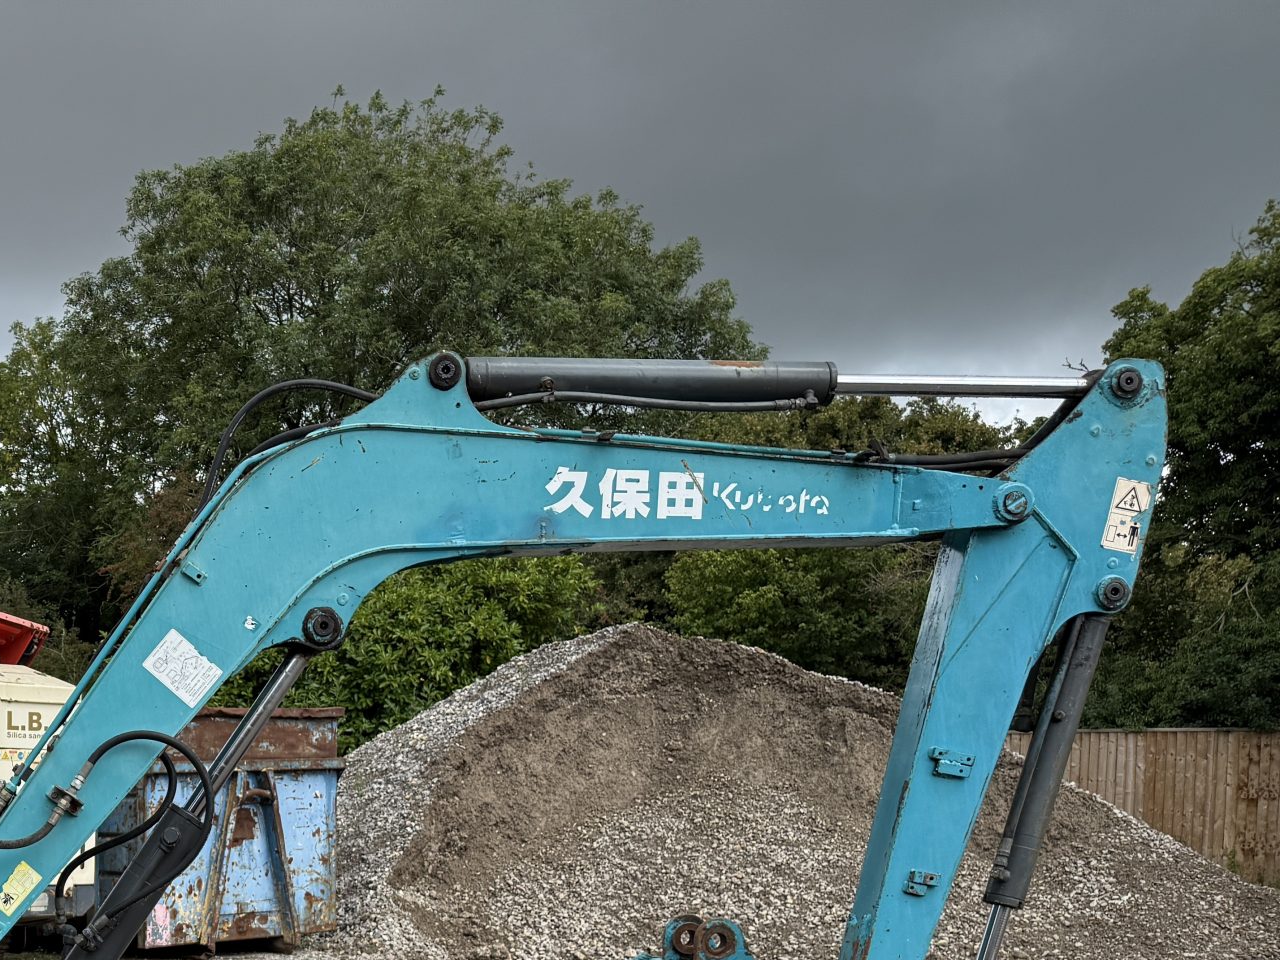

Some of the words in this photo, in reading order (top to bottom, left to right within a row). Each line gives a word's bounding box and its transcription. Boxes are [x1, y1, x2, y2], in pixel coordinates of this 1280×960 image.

[543, 466, 704, 519] 久保田
[7, 731, 27, 739] Silica
